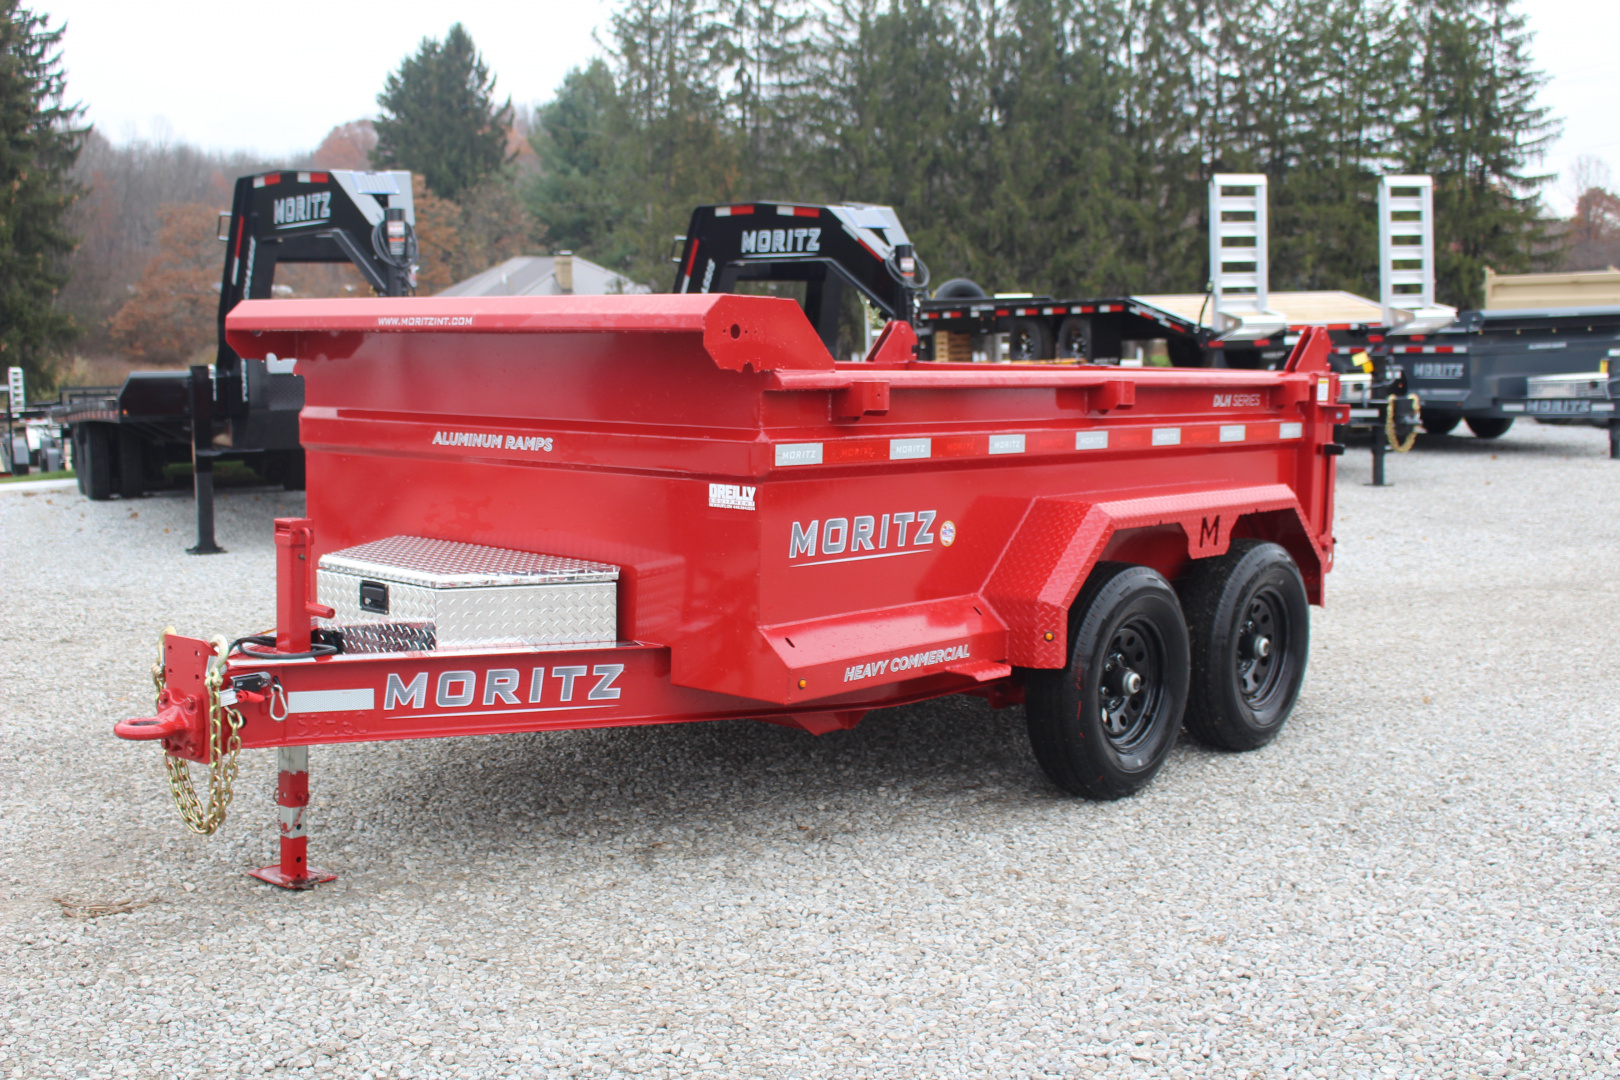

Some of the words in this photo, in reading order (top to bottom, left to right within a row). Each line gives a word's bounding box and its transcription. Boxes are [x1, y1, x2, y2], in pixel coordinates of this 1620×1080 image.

[273, 191, 331, 224] MORITZ
[741, 228, 821, 253] MORITZ
[378, 316, 473, 326] WWW.MORITZINT.COM
[1413, 362, 1465, 377] MORITZ
[1232, 393, 1261, 407] SERIES
[1526, 400, 1591, 413] MORITZ
[432, 431, 503, 449] ALUMINUM
[504, 435, 554, 452] RAMPS
[894, 444, 926, 454] MORITZ
[781, 450, 817, 460] MORITZ
[789, 509, 937, 559] MORITZ
[1199, 514, 1221, 548] M
[843, 659, 890, 682] HEAVY
[890, 644, 970, 672] COMMERCIAL
[384, 663, 625, 710] MORITZ
